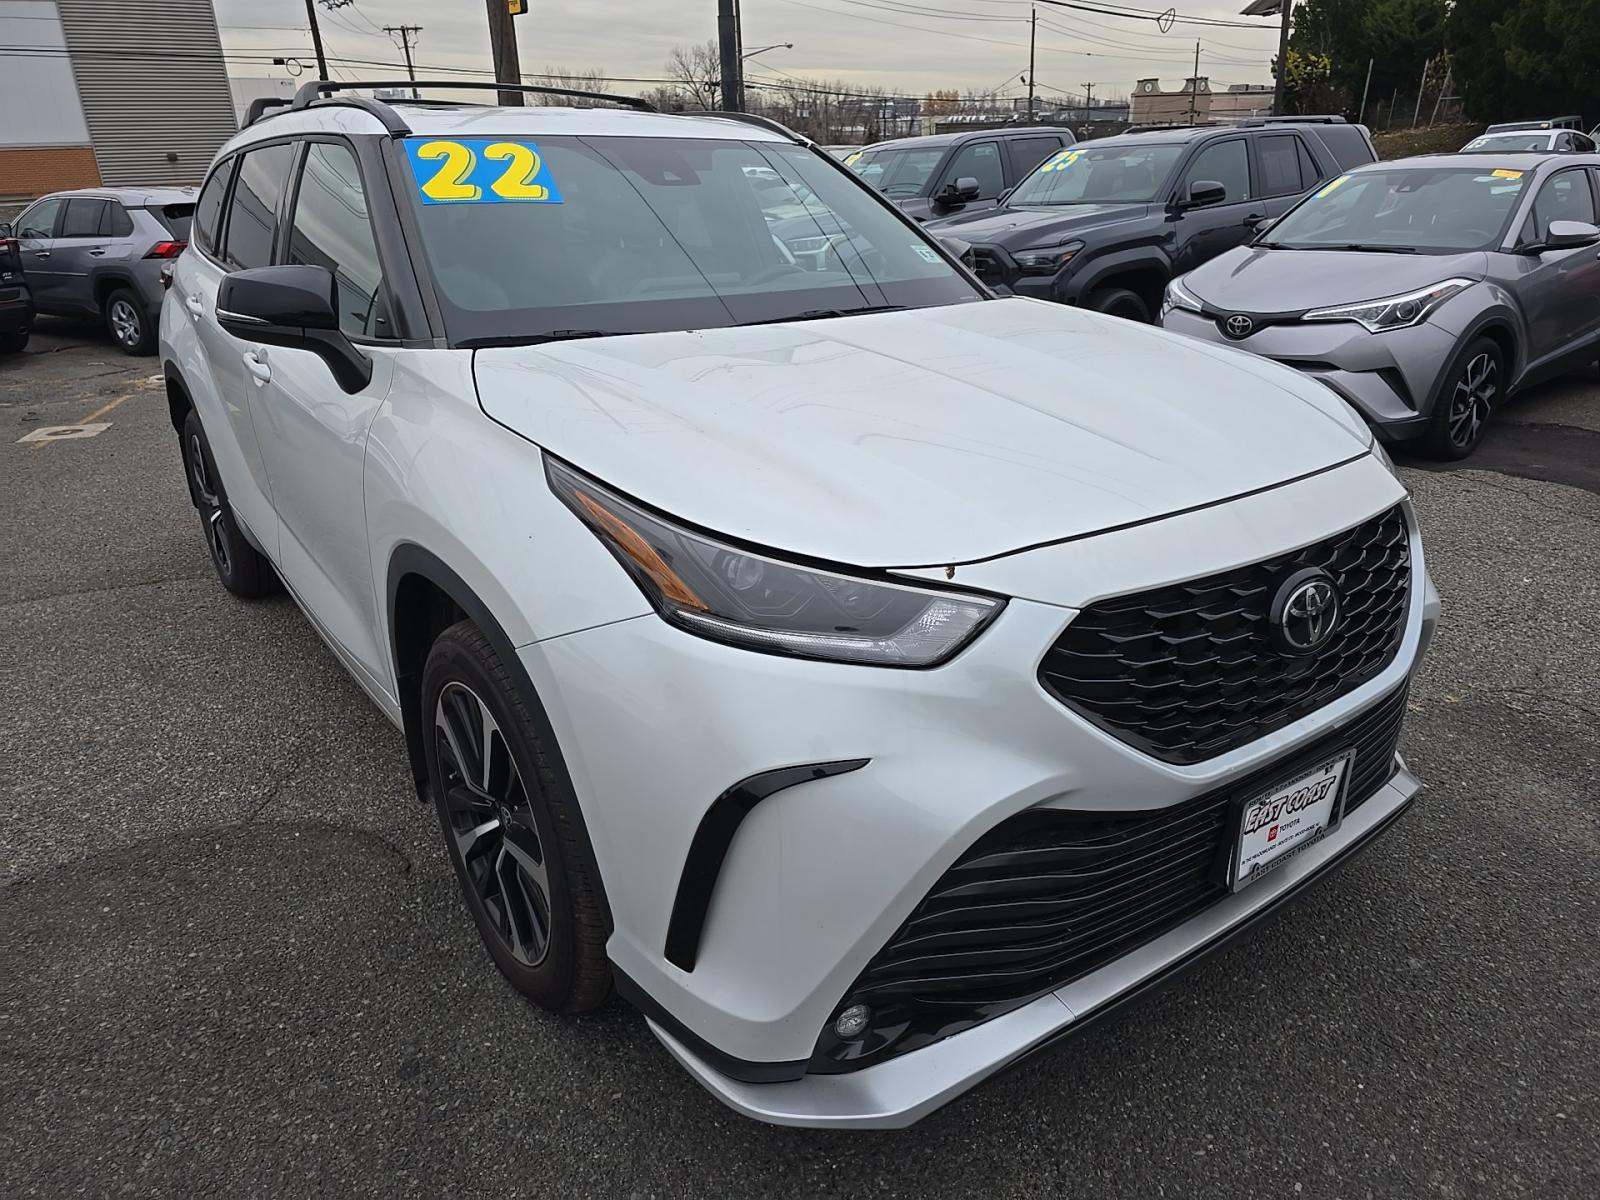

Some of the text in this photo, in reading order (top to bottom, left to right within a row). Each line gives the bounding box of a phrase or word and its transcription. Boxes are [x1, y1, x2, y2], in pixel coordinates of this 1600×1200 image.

[417, 141, 549, 201] 22
[1244, 795, 1288, 834] EAST
[1286, 775, 1337, 815] COAST
[1279, 818, 1301, 833] TOYOTA
[1249, 866, 1269, 881] EAST
[1271, 850, 1297, 869] COAST
[1297, 833, 1326, 853] TOYOTA
